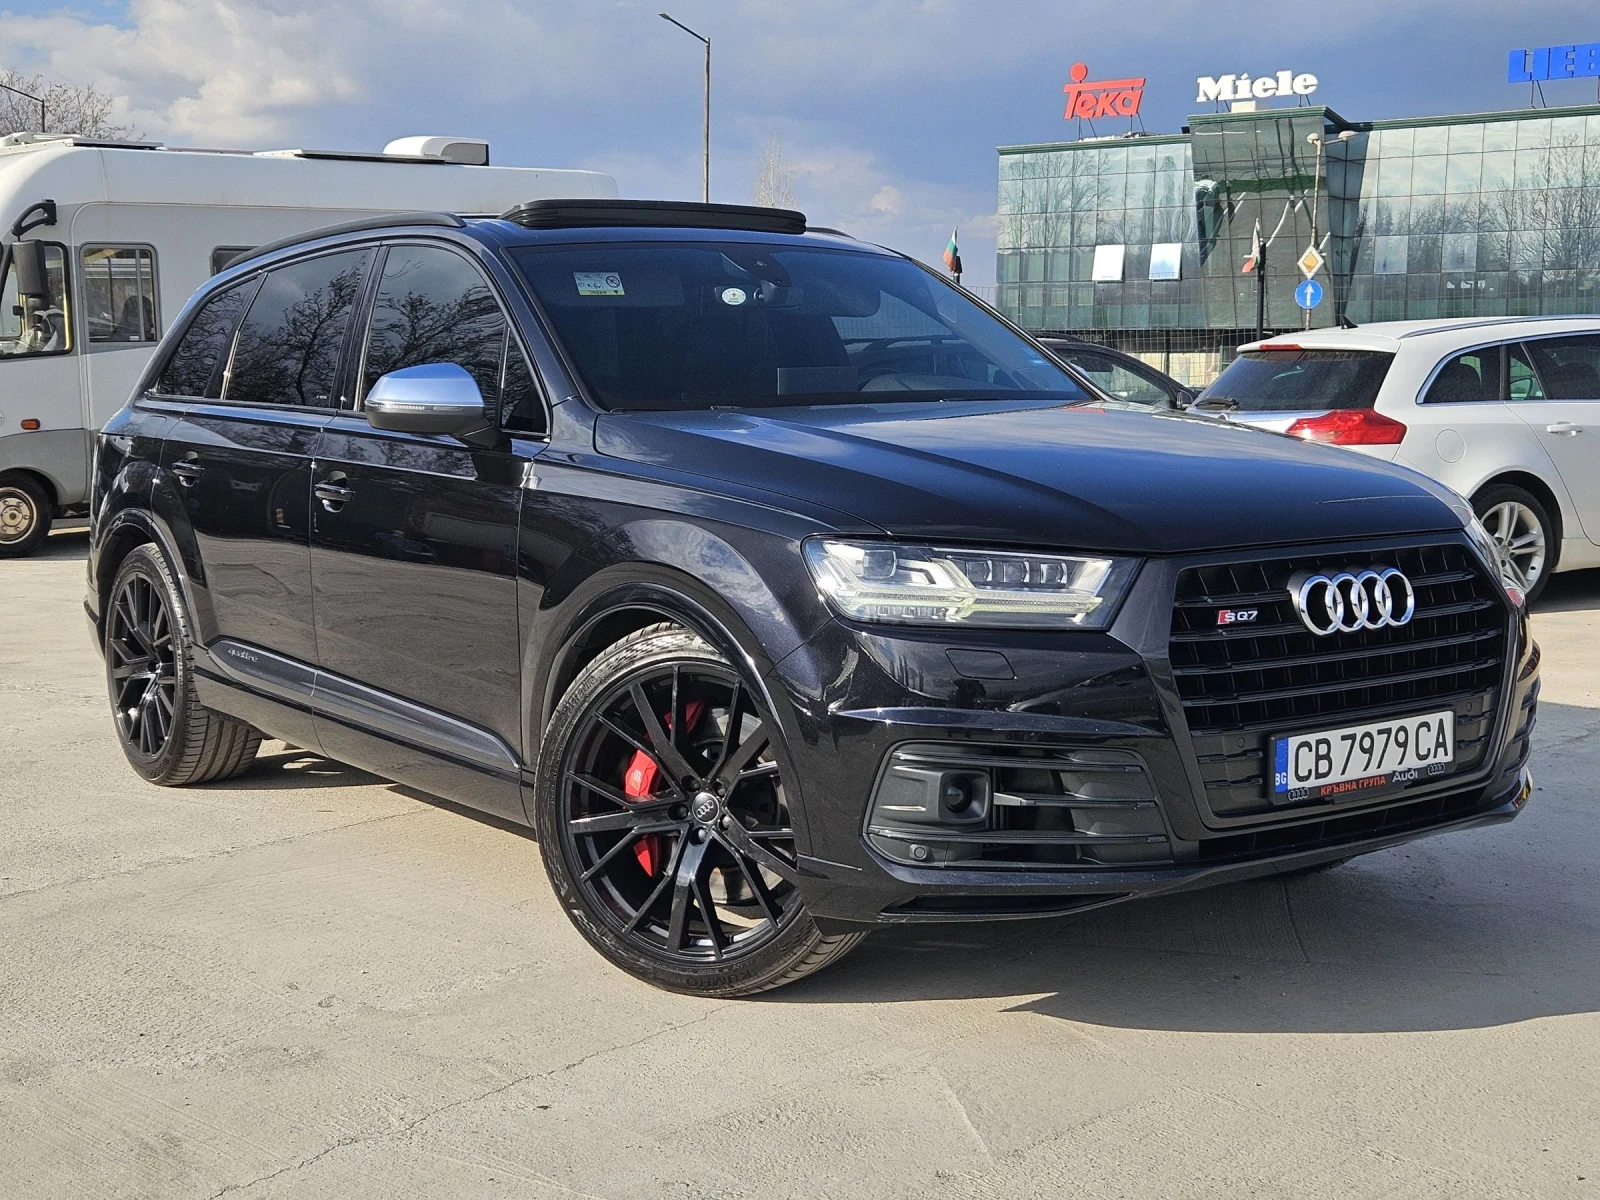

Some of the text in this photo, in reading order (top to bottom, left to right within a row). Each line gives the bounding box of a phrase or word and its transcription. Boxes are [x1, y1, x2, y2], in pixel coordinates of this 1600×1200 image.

[1507, 43, 1600, 83] LIEB
[1196, 70, 1319, 102] Miele
[1223, 610, 1258, 623] SQ7
[1294, 717, 1449, 783] CB 7979 CA
[1275, 772, 1287, 786] BG
[1320, 775, 1387, 796] КРЪВНА ГРУПА
[1392, 768, 1418, 783] Audi
